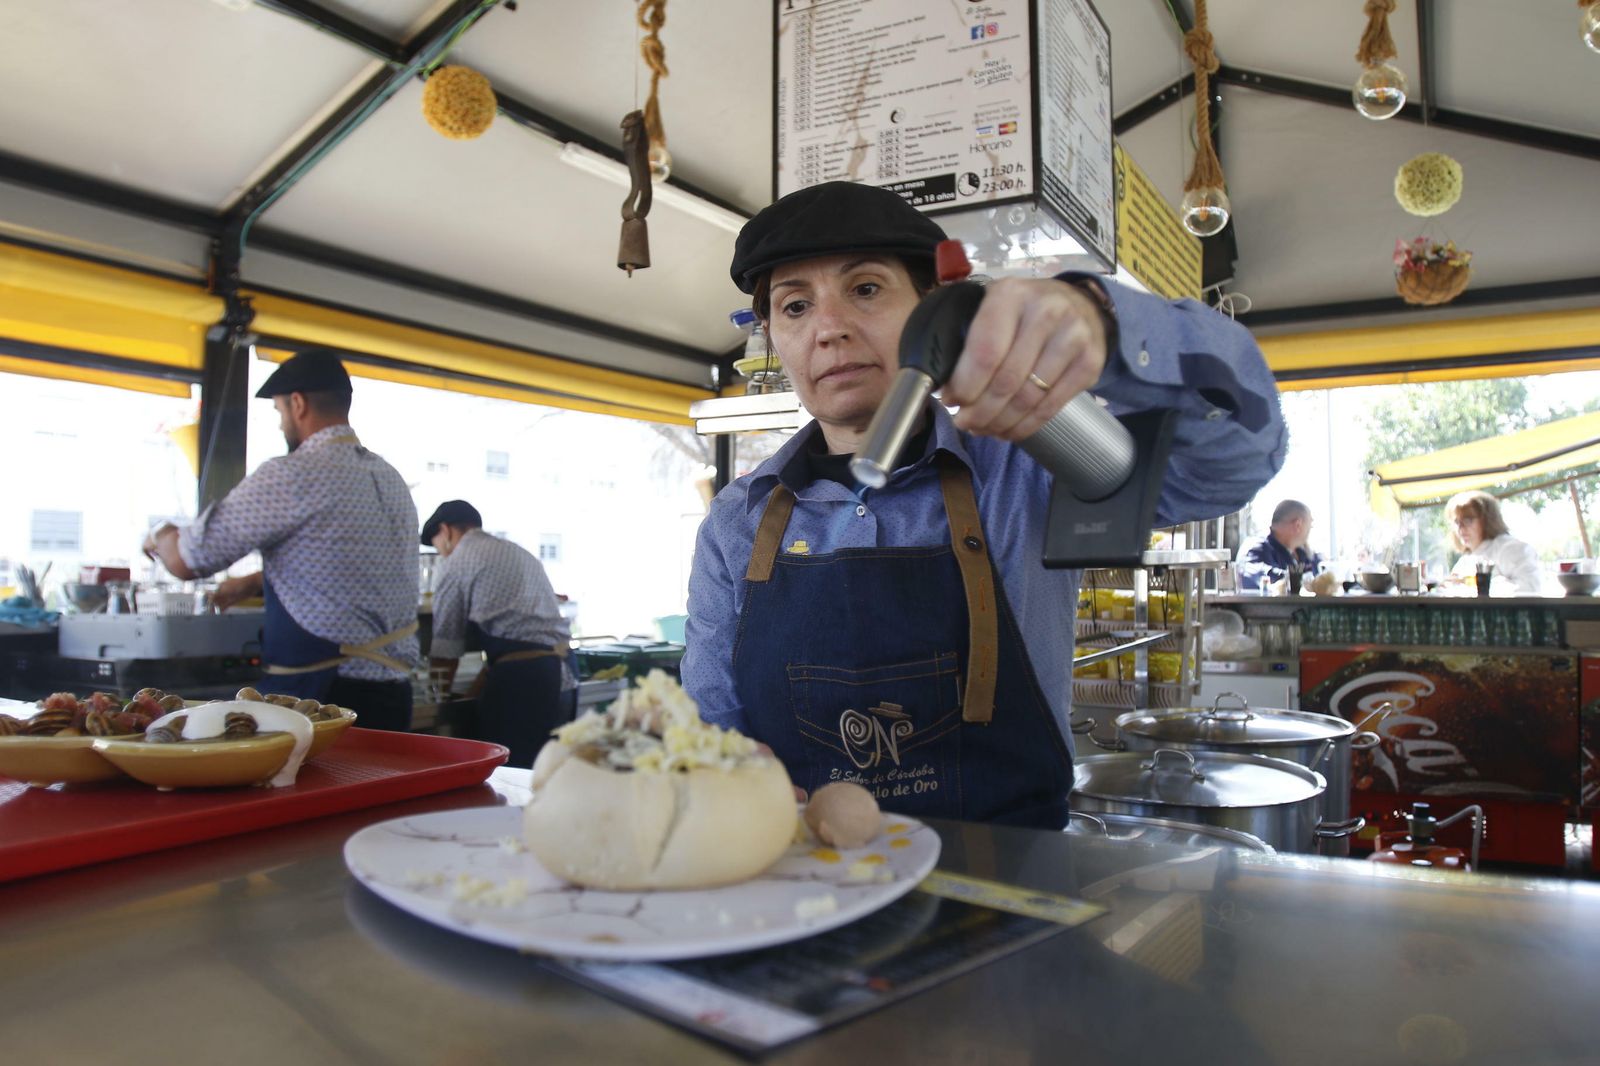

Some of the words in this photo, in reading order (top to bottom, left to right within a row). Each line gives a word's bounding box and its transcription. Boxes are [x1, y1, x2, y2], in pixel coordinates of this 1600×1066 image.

[969, 139, 1013, 154] Horario
[982, 164, 1013, 178] 11:30
[1016, 161, 1026, 173] h.
[904, 180, 926, 189] mesa
[982, 179, 1014, 193] 23:00
[1016, 177, 1026, 189] h.
[912, 196, 924, 205] de
[924, 193, 935, 203] 18
[936, 192, 955, 201] años
[829, 768, 842, 780] El
[887, 764, 935, 781] Córdoba
[893, 784, 911, 797] de
[913, 780, 938, 793] Oro
